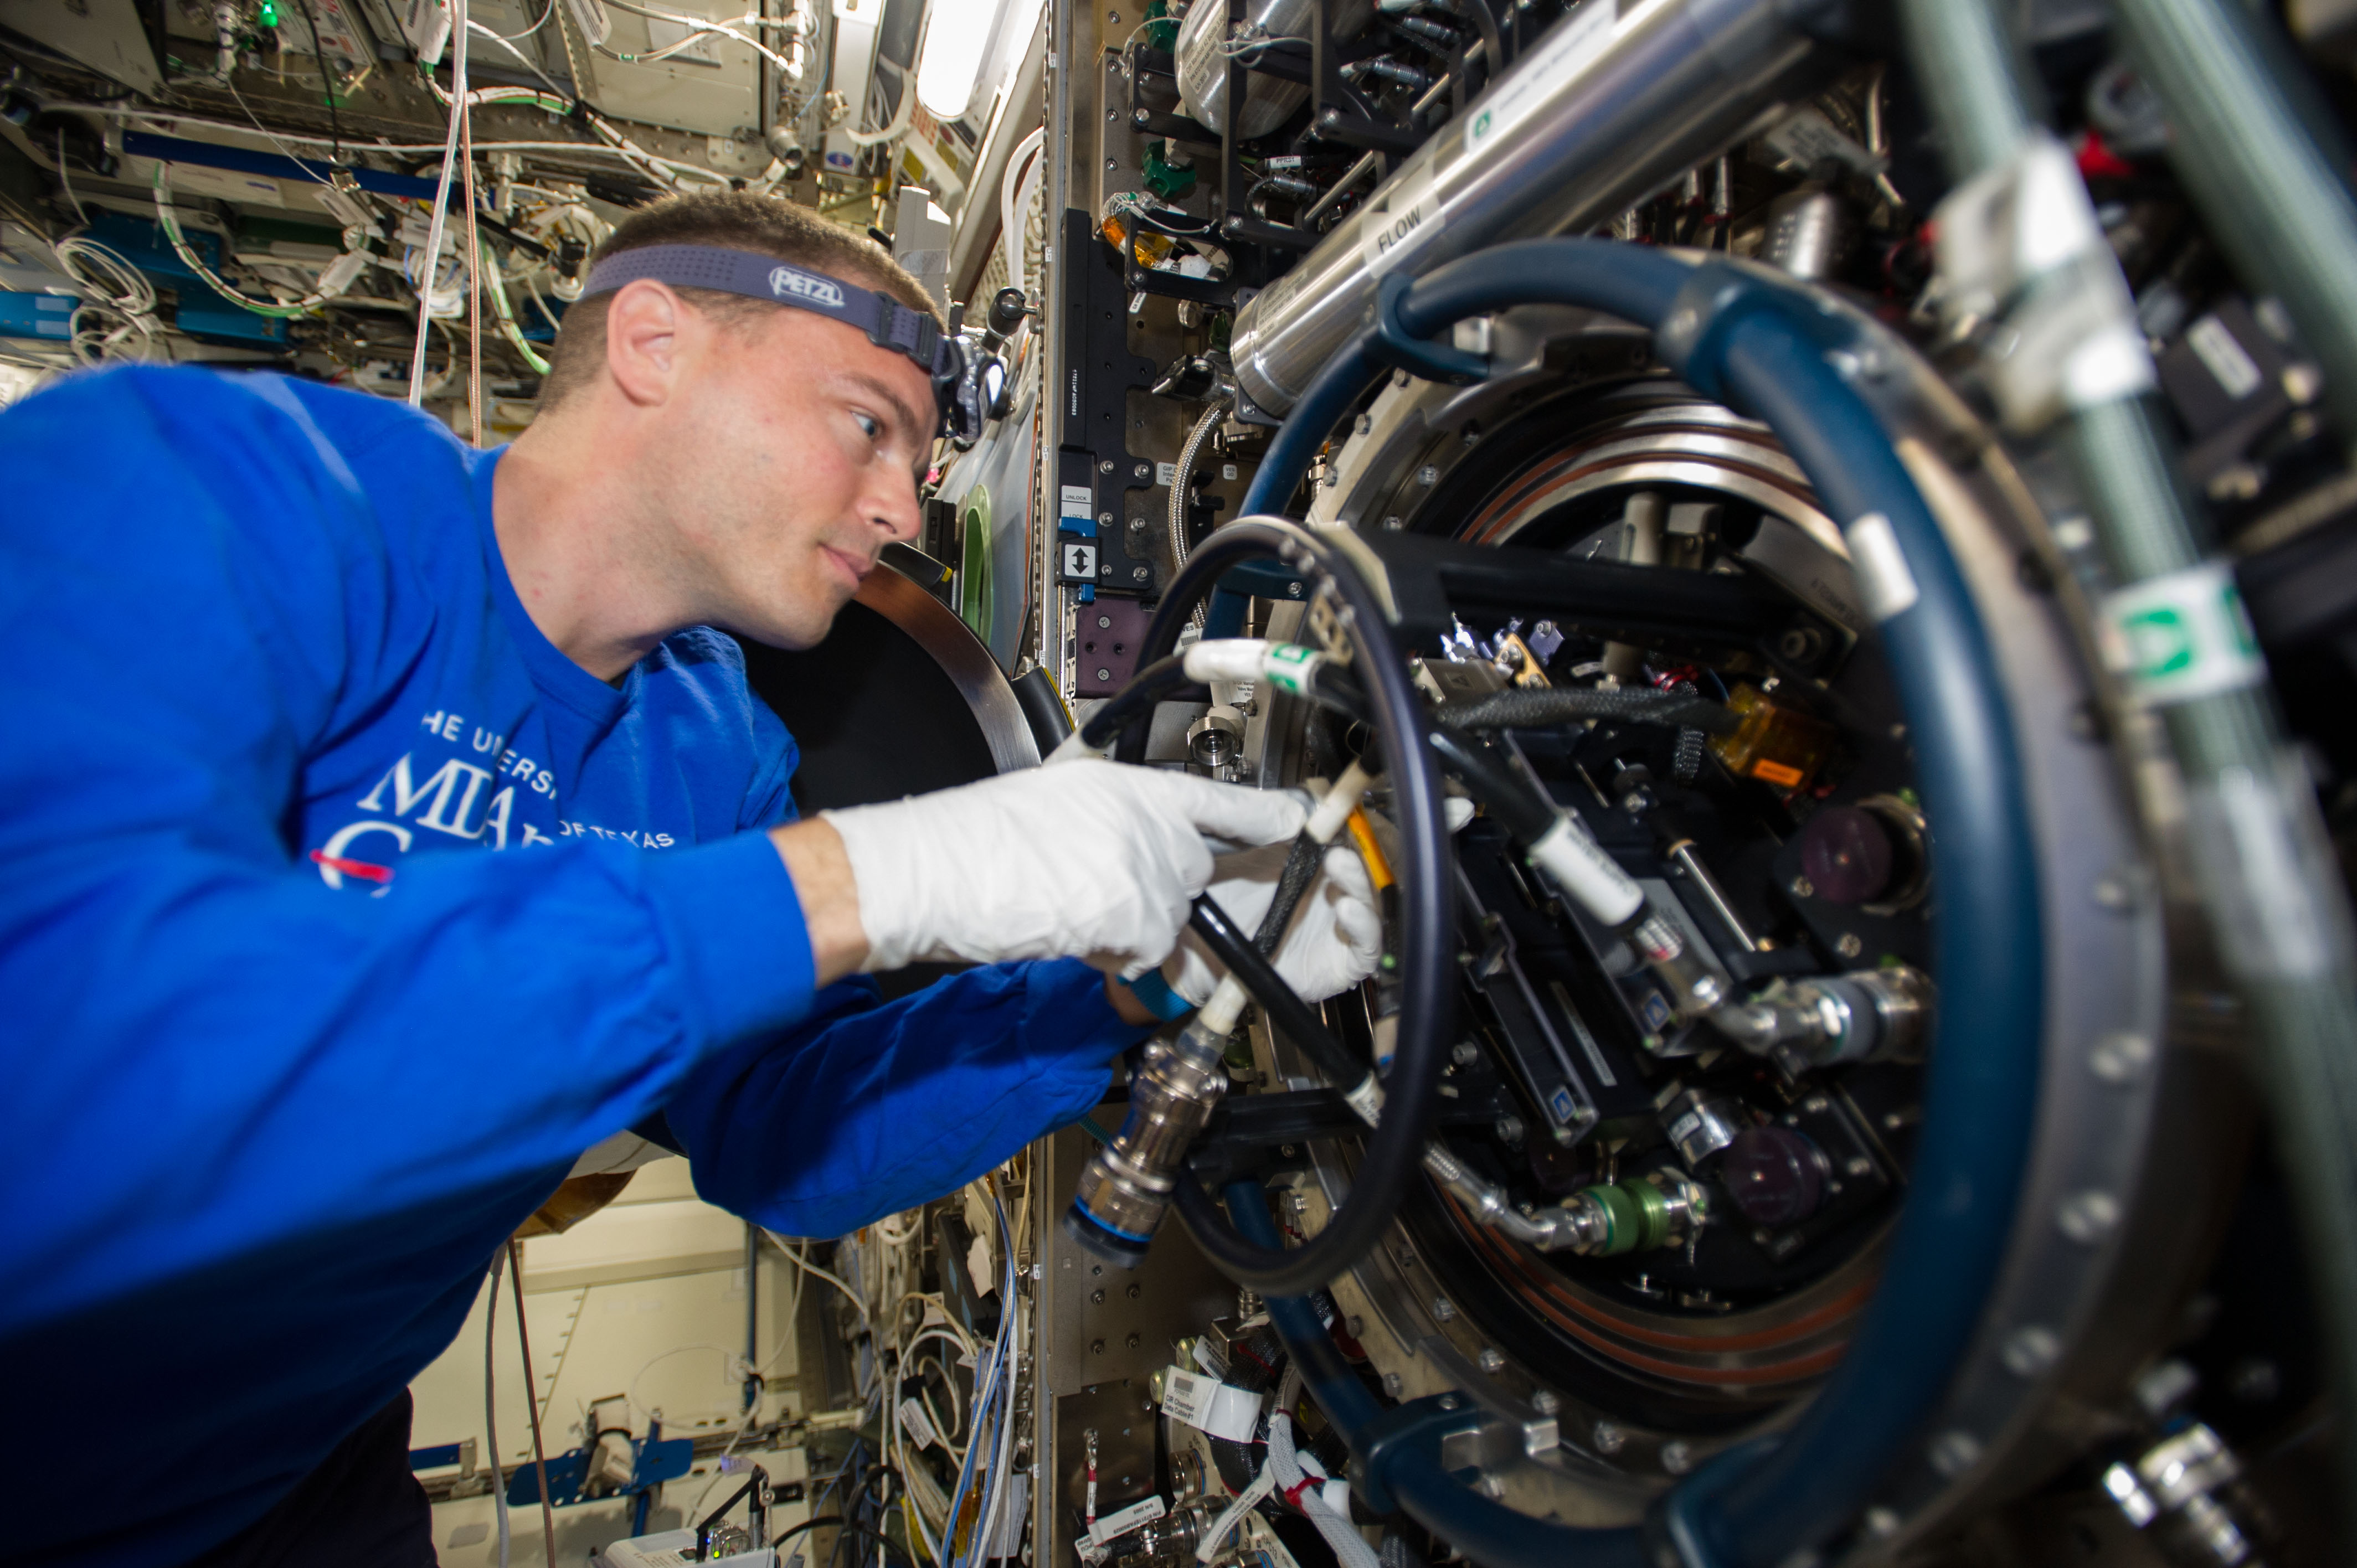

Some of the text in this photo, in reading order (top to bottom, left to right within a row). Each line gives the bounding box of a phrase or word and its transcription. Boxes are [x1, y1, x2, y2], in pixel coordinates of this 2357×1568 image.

[1377, 204, 1421, 255] FLOW
[772, 268, 846, 306] PETZL
[1164, 1402, 1174, 1412] Data
[1166, 1394, 1195, 1412] CIR Chamber
